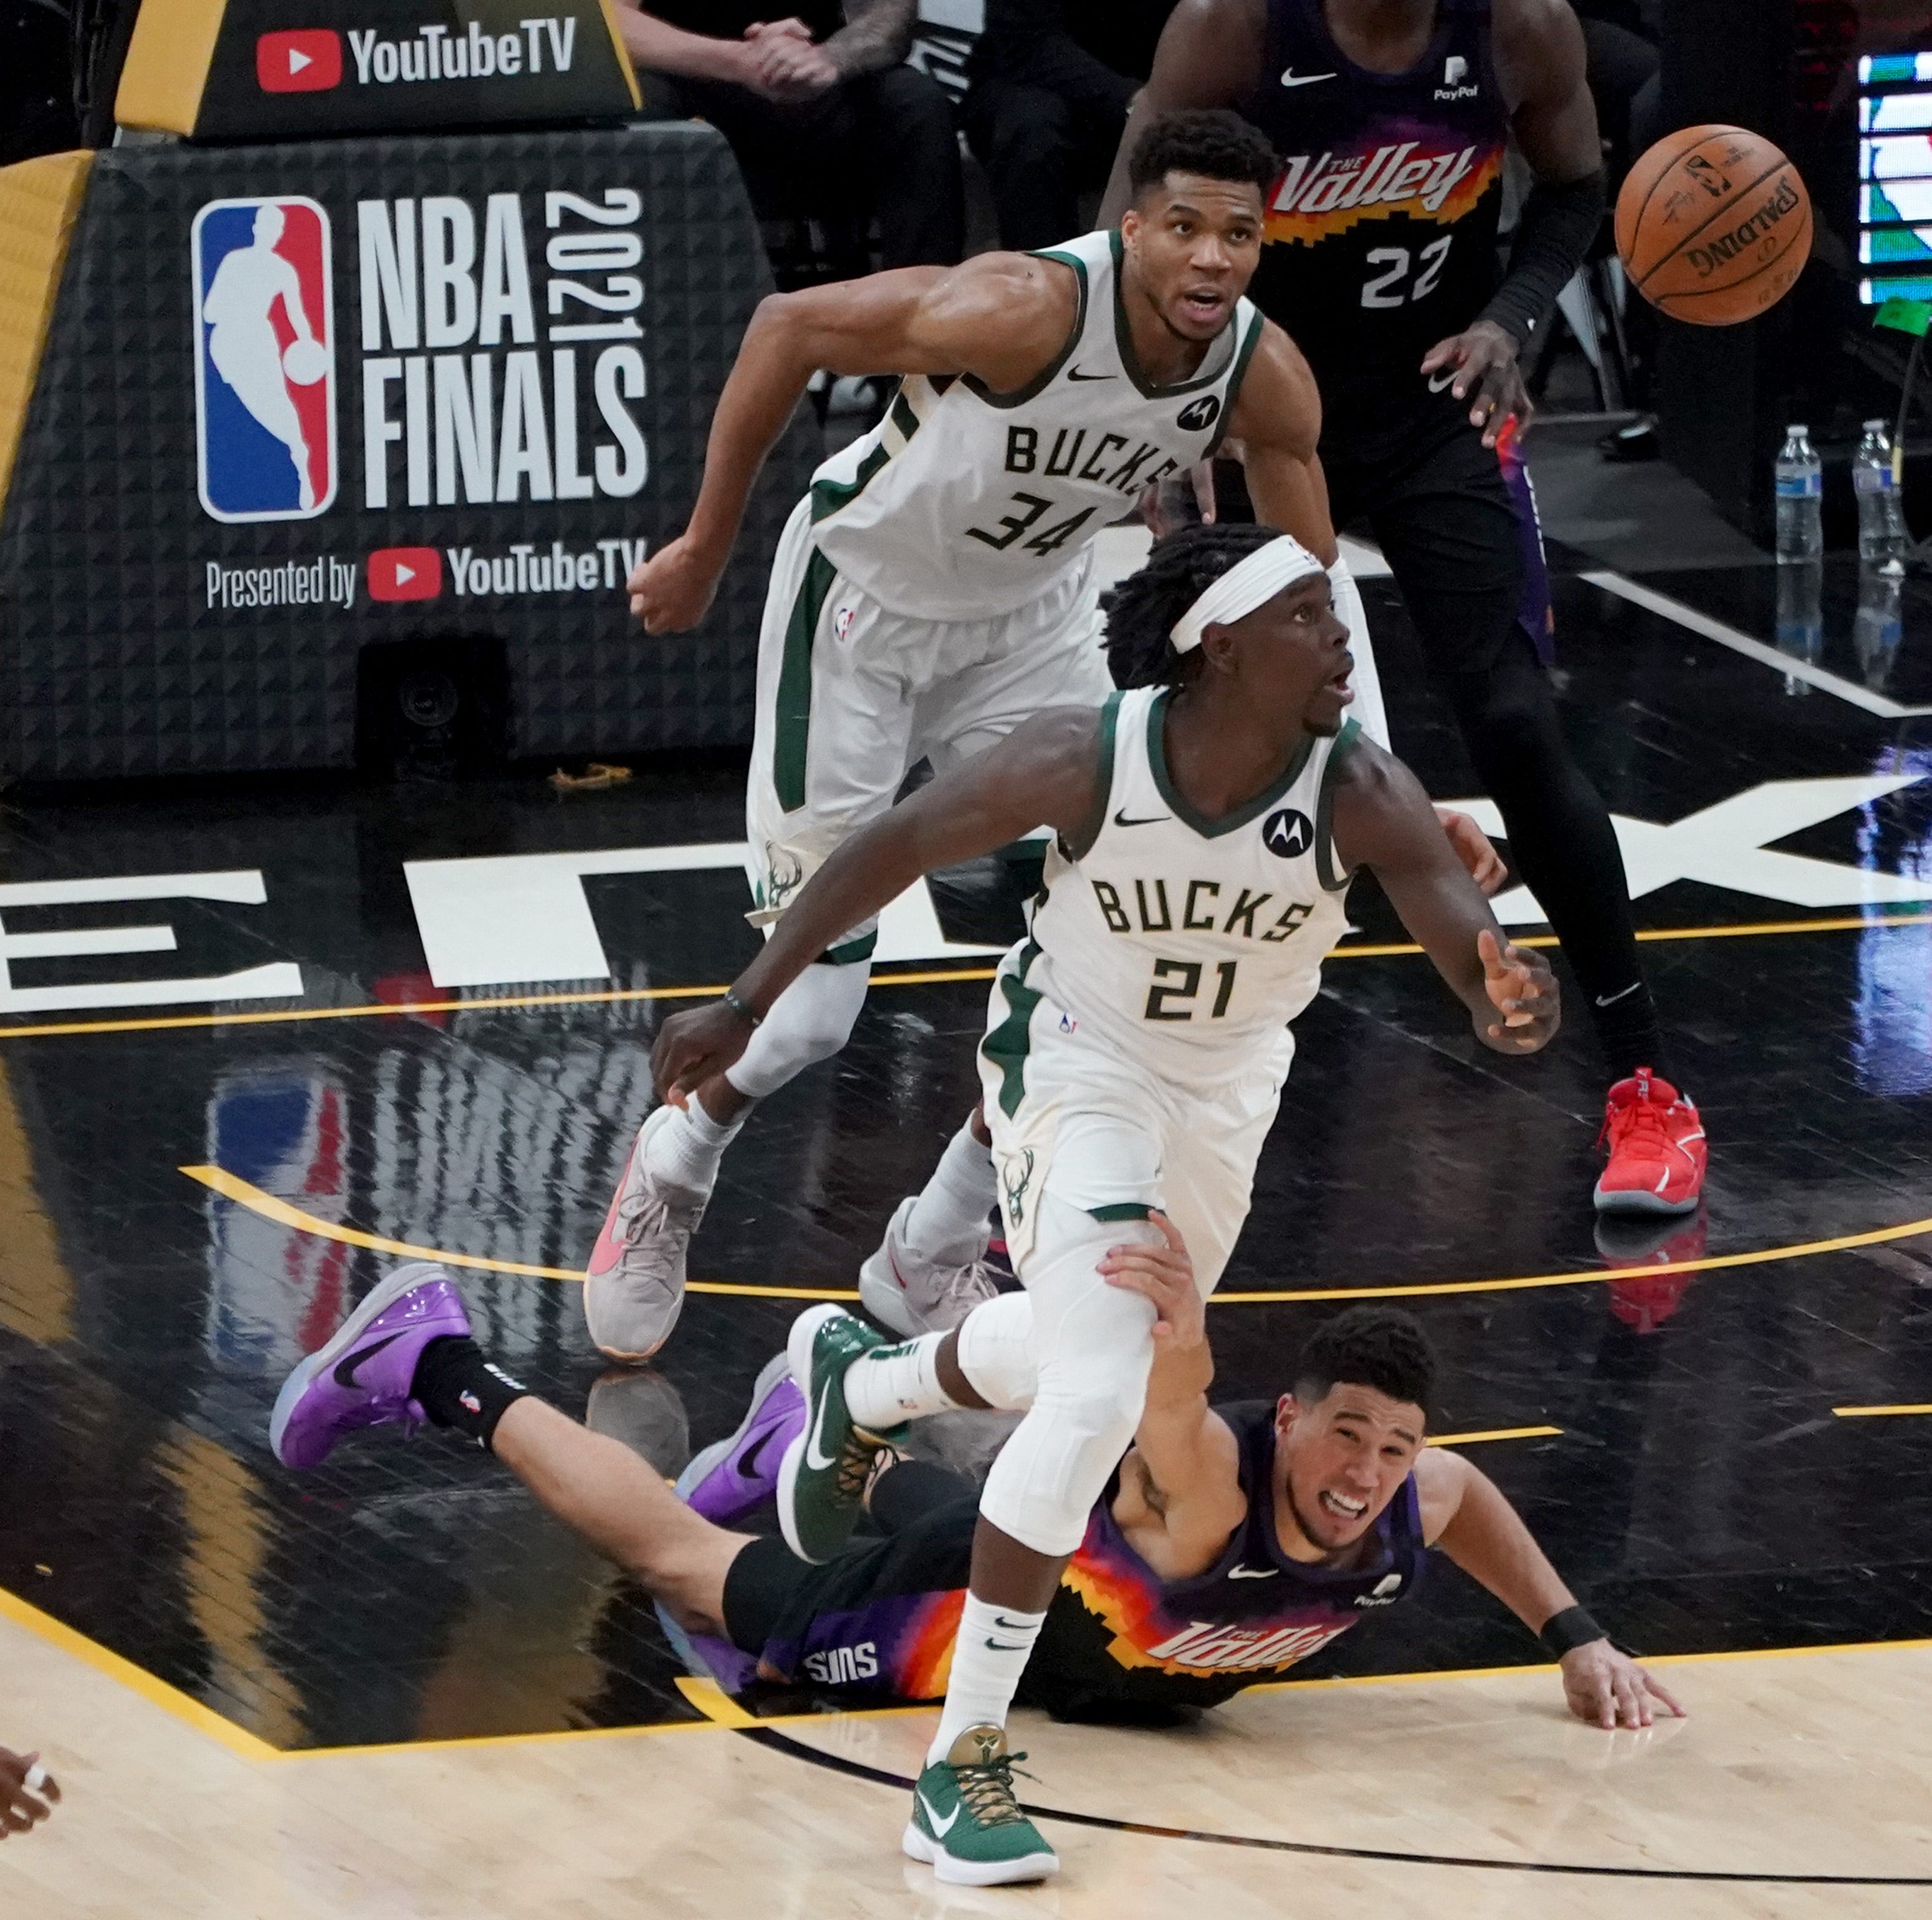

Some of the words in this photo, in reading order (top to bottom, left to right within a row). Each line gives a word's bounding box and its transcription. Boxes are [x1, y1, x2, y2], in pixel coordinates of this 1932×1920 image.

[1434, 85, 1478, 100] PayPal
[1273, 141, 1477, 213] Valley
[1329, 156, 1366, 173] THE
[1685, 176, 1799, 277] SPALDING
[356, 193, 536, 351] NBA
[545, 189, 644, 341] 2021
[1361, 234, 1452, 308] 22
[362, 346, 648, 508] FINALS
[965, 492, 1099, 557] 34
[206, 556, 323, 608] Presented
[329, 556, 356, 609] by
[1091, 879, 1314, 943] BUCKS
[1144, 958, 1238, 1021] 21
